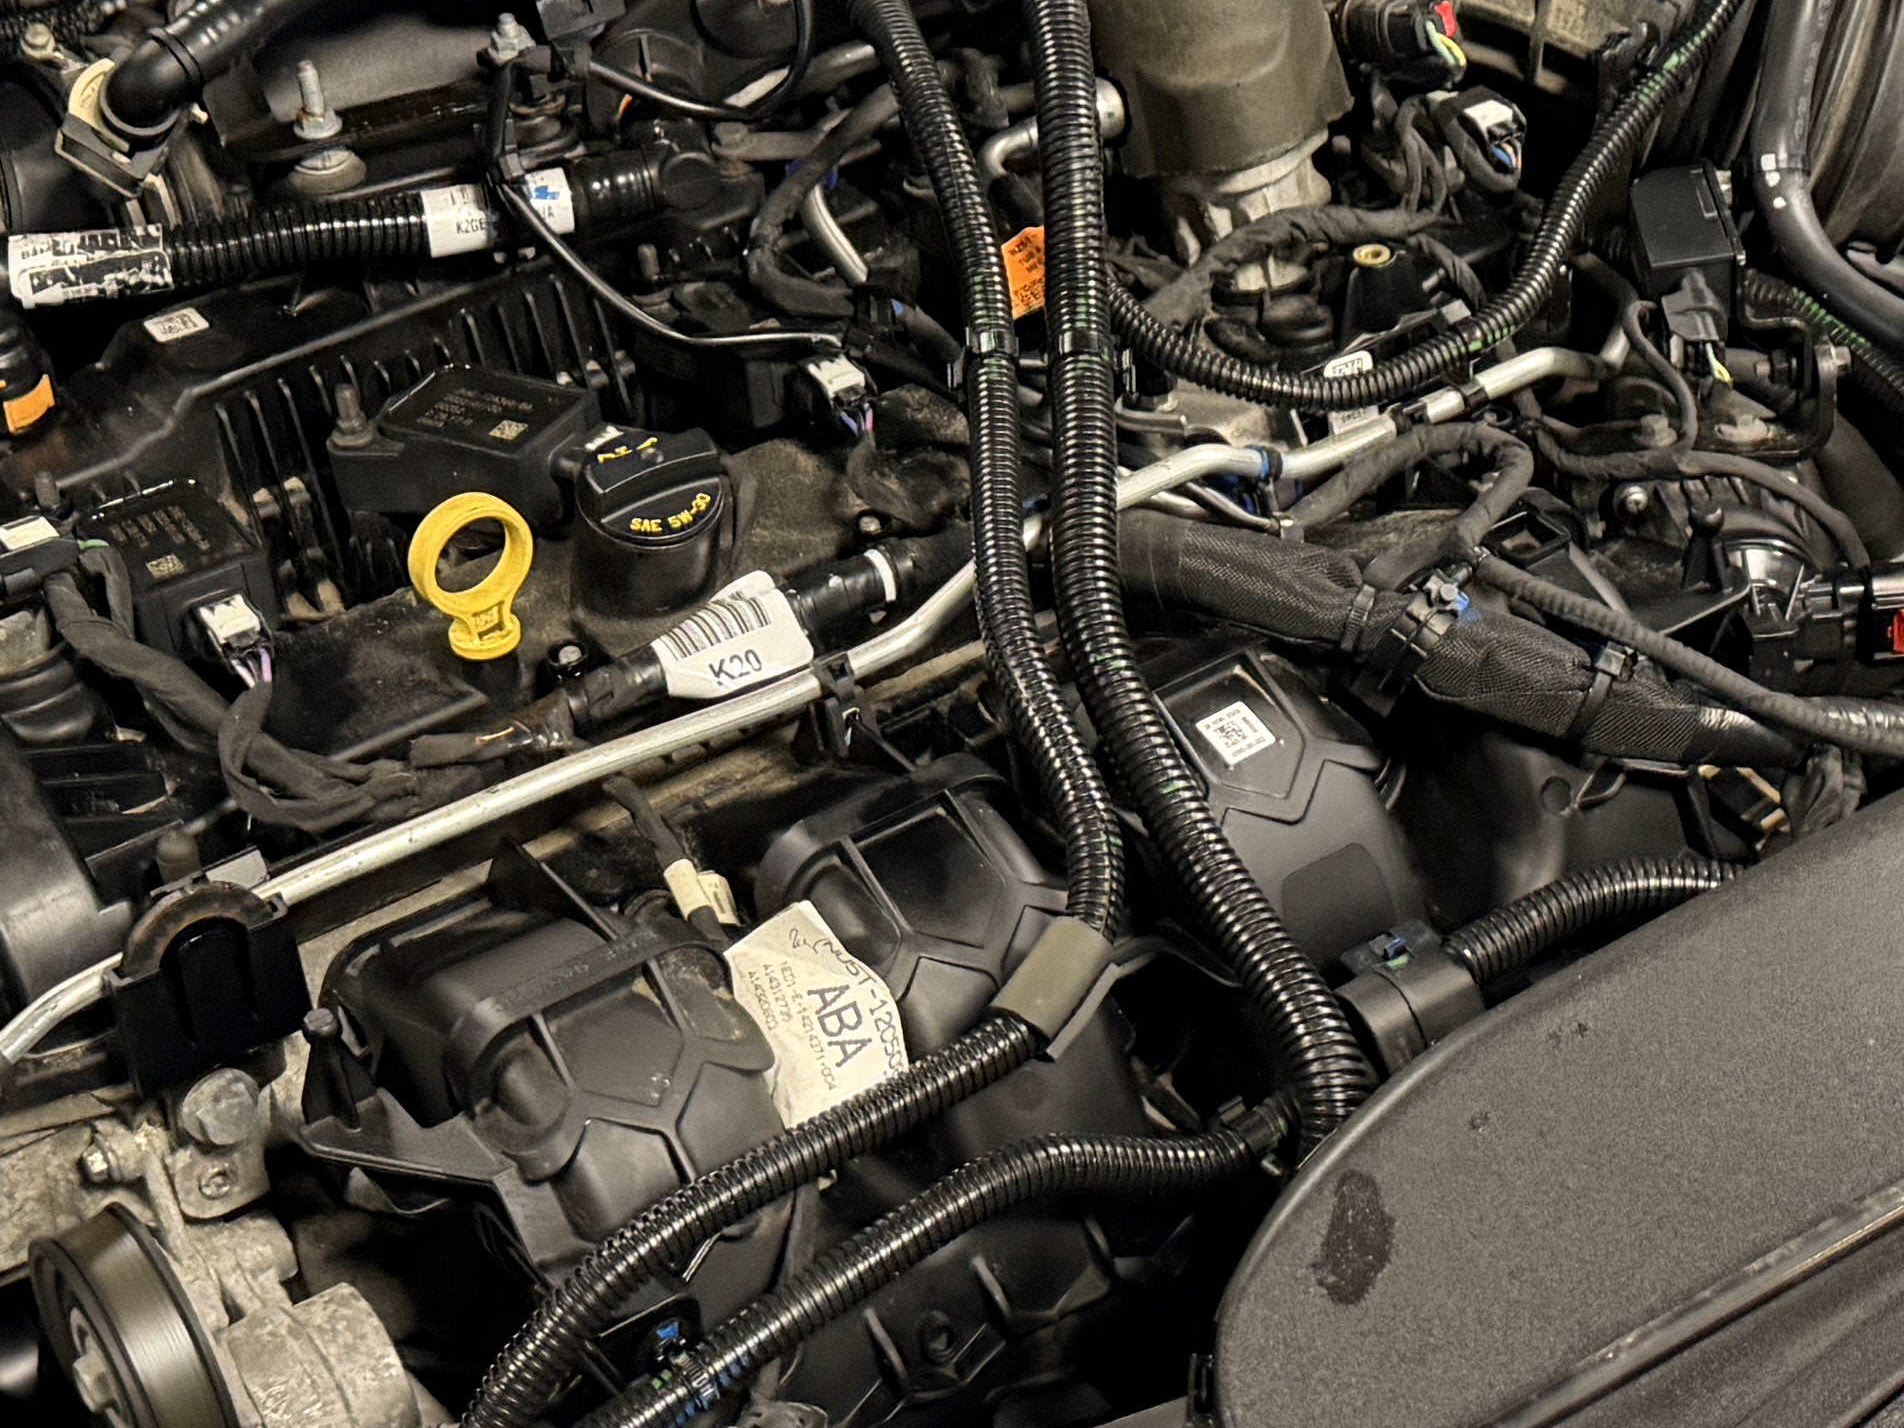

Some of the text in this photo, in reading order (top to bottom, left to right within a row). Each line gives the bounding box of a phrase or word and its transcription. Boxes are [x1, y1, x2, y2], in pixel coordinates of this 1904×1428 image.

[628, 491, 713, 534] SAE 5W-30
[707, 648, 764, 687] K20
[806, 983, 872, 1068] ABA
